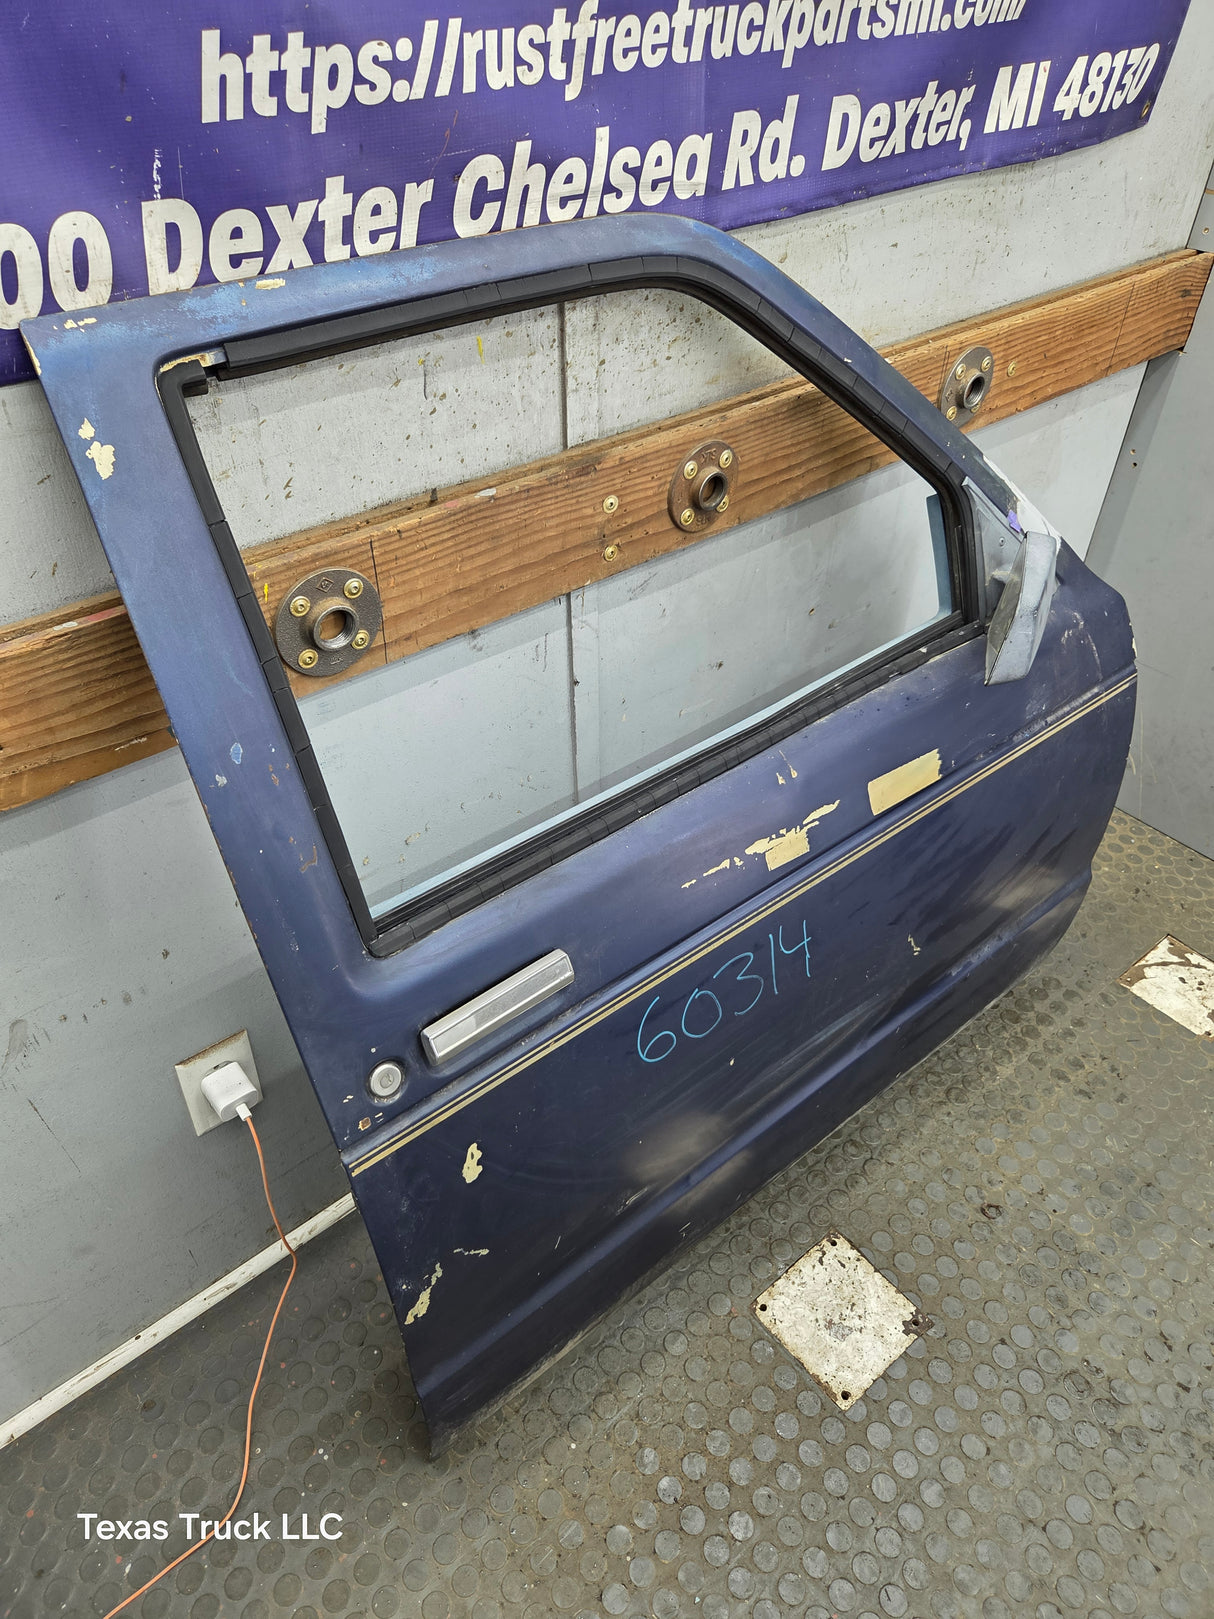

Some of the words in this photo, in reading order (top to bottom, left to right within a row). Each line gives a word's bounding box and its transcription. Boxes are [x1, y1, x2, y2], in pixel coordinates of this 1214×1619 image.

[141, 176, 434, 297] Dexter
[453, 125, 713, 239] Chelsea
[722, 95, 805, 190] Rd.
[822, 80, 976, 171] Dexter,
[983, 60, 1051, 134] MI
[1053, 43, 1160, 121] 48130
[637, 919, 812, 1063] 60314
